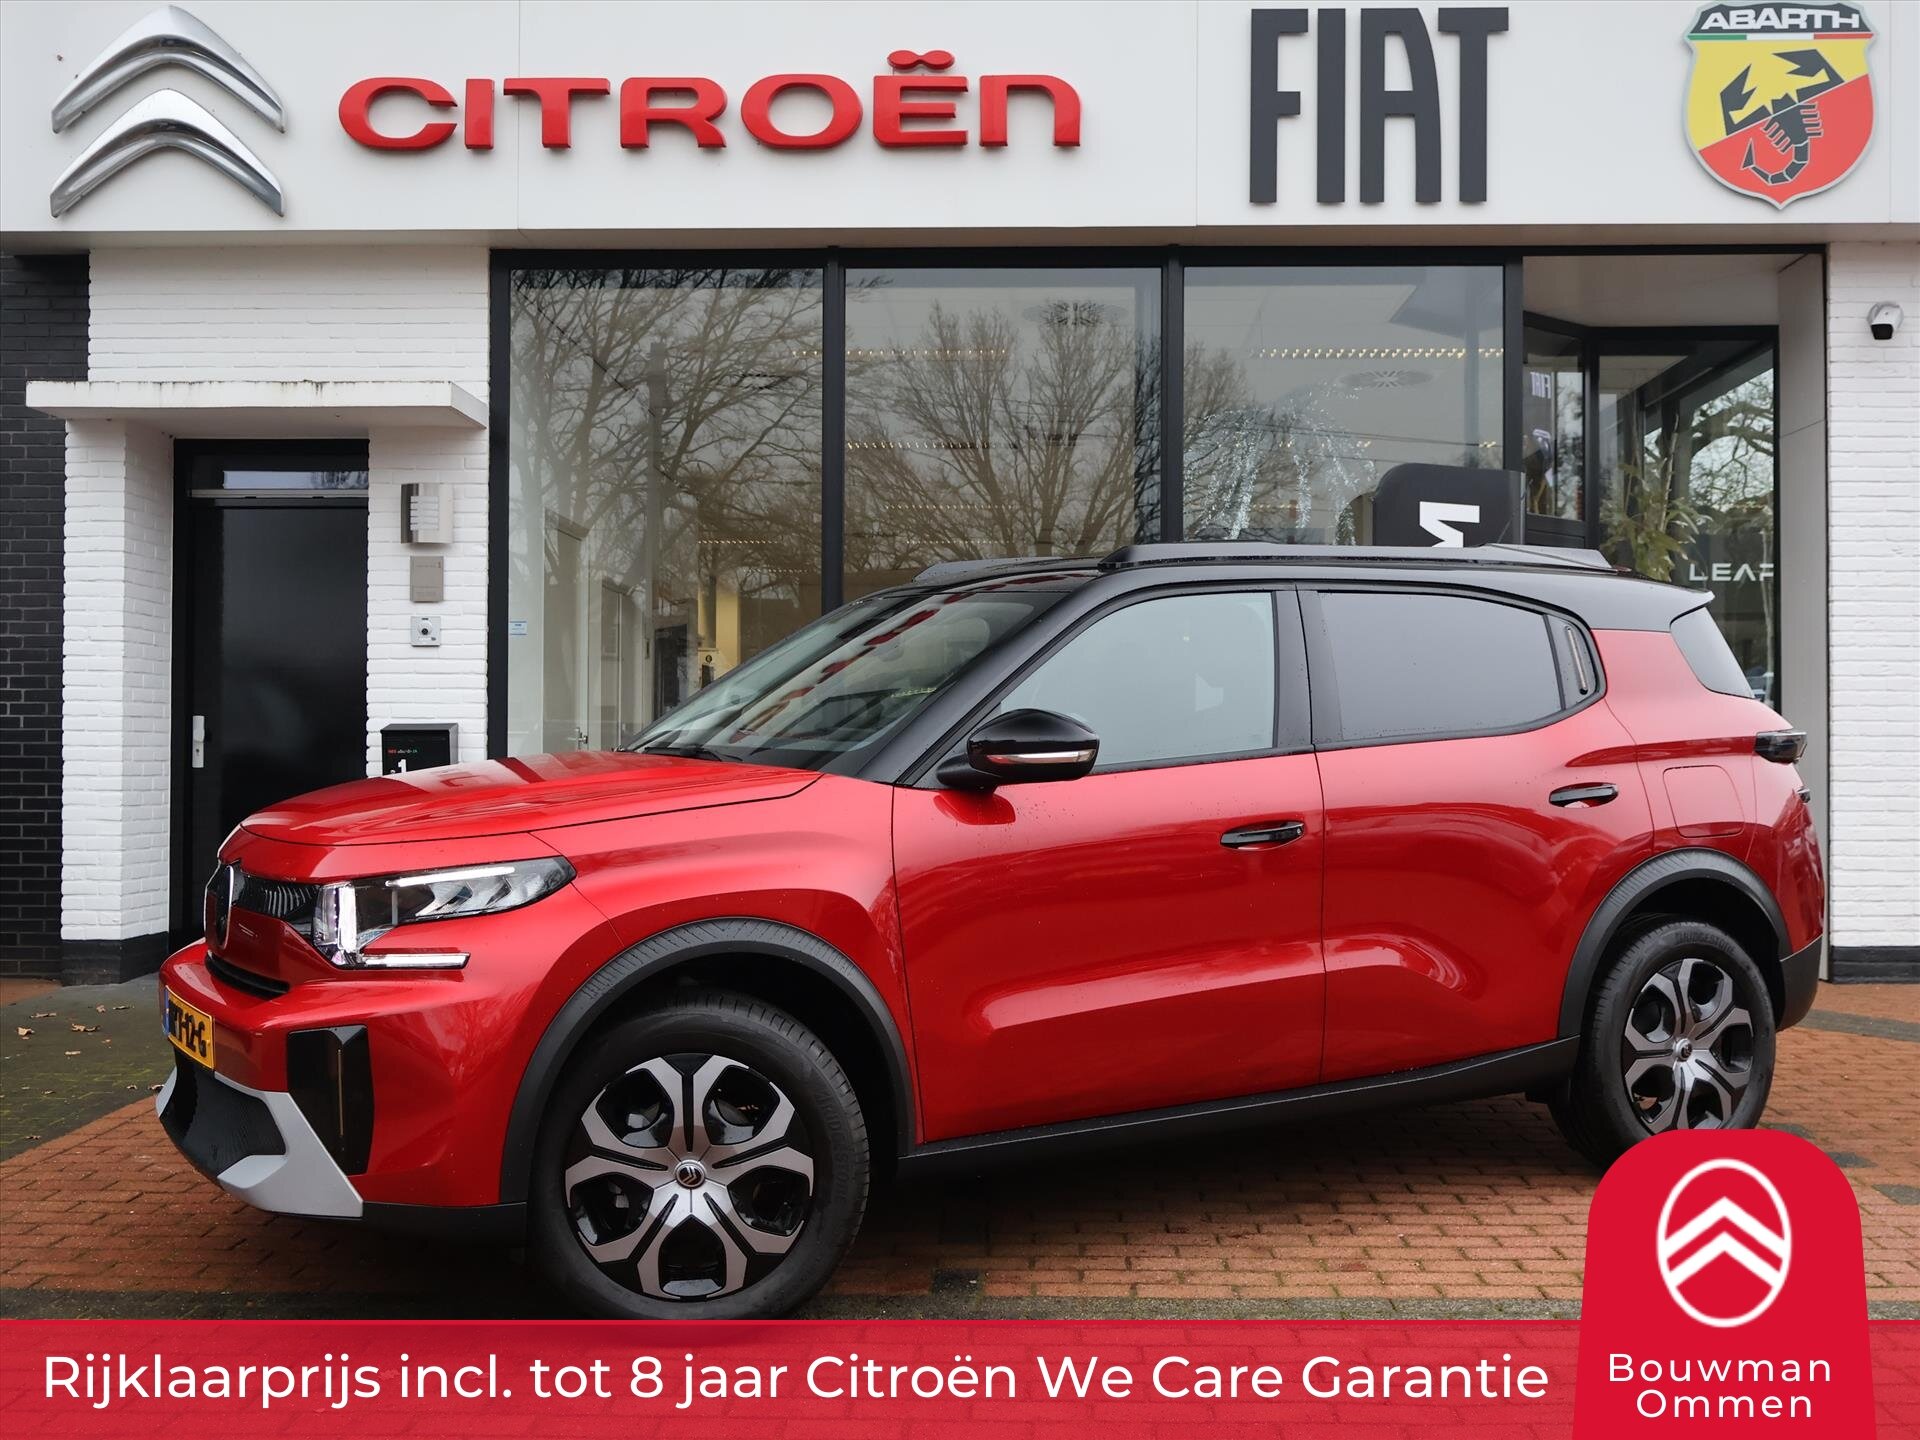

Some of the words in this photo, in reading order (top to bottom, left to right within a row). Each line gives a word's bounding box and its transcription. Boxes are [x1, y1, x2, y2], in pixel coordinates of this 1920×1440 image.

[1700, 7, 1860, 30] ABARTH
[339, 49, 1082, 150] CITROËN
[1250, 8, 1509, 205] FIAT
